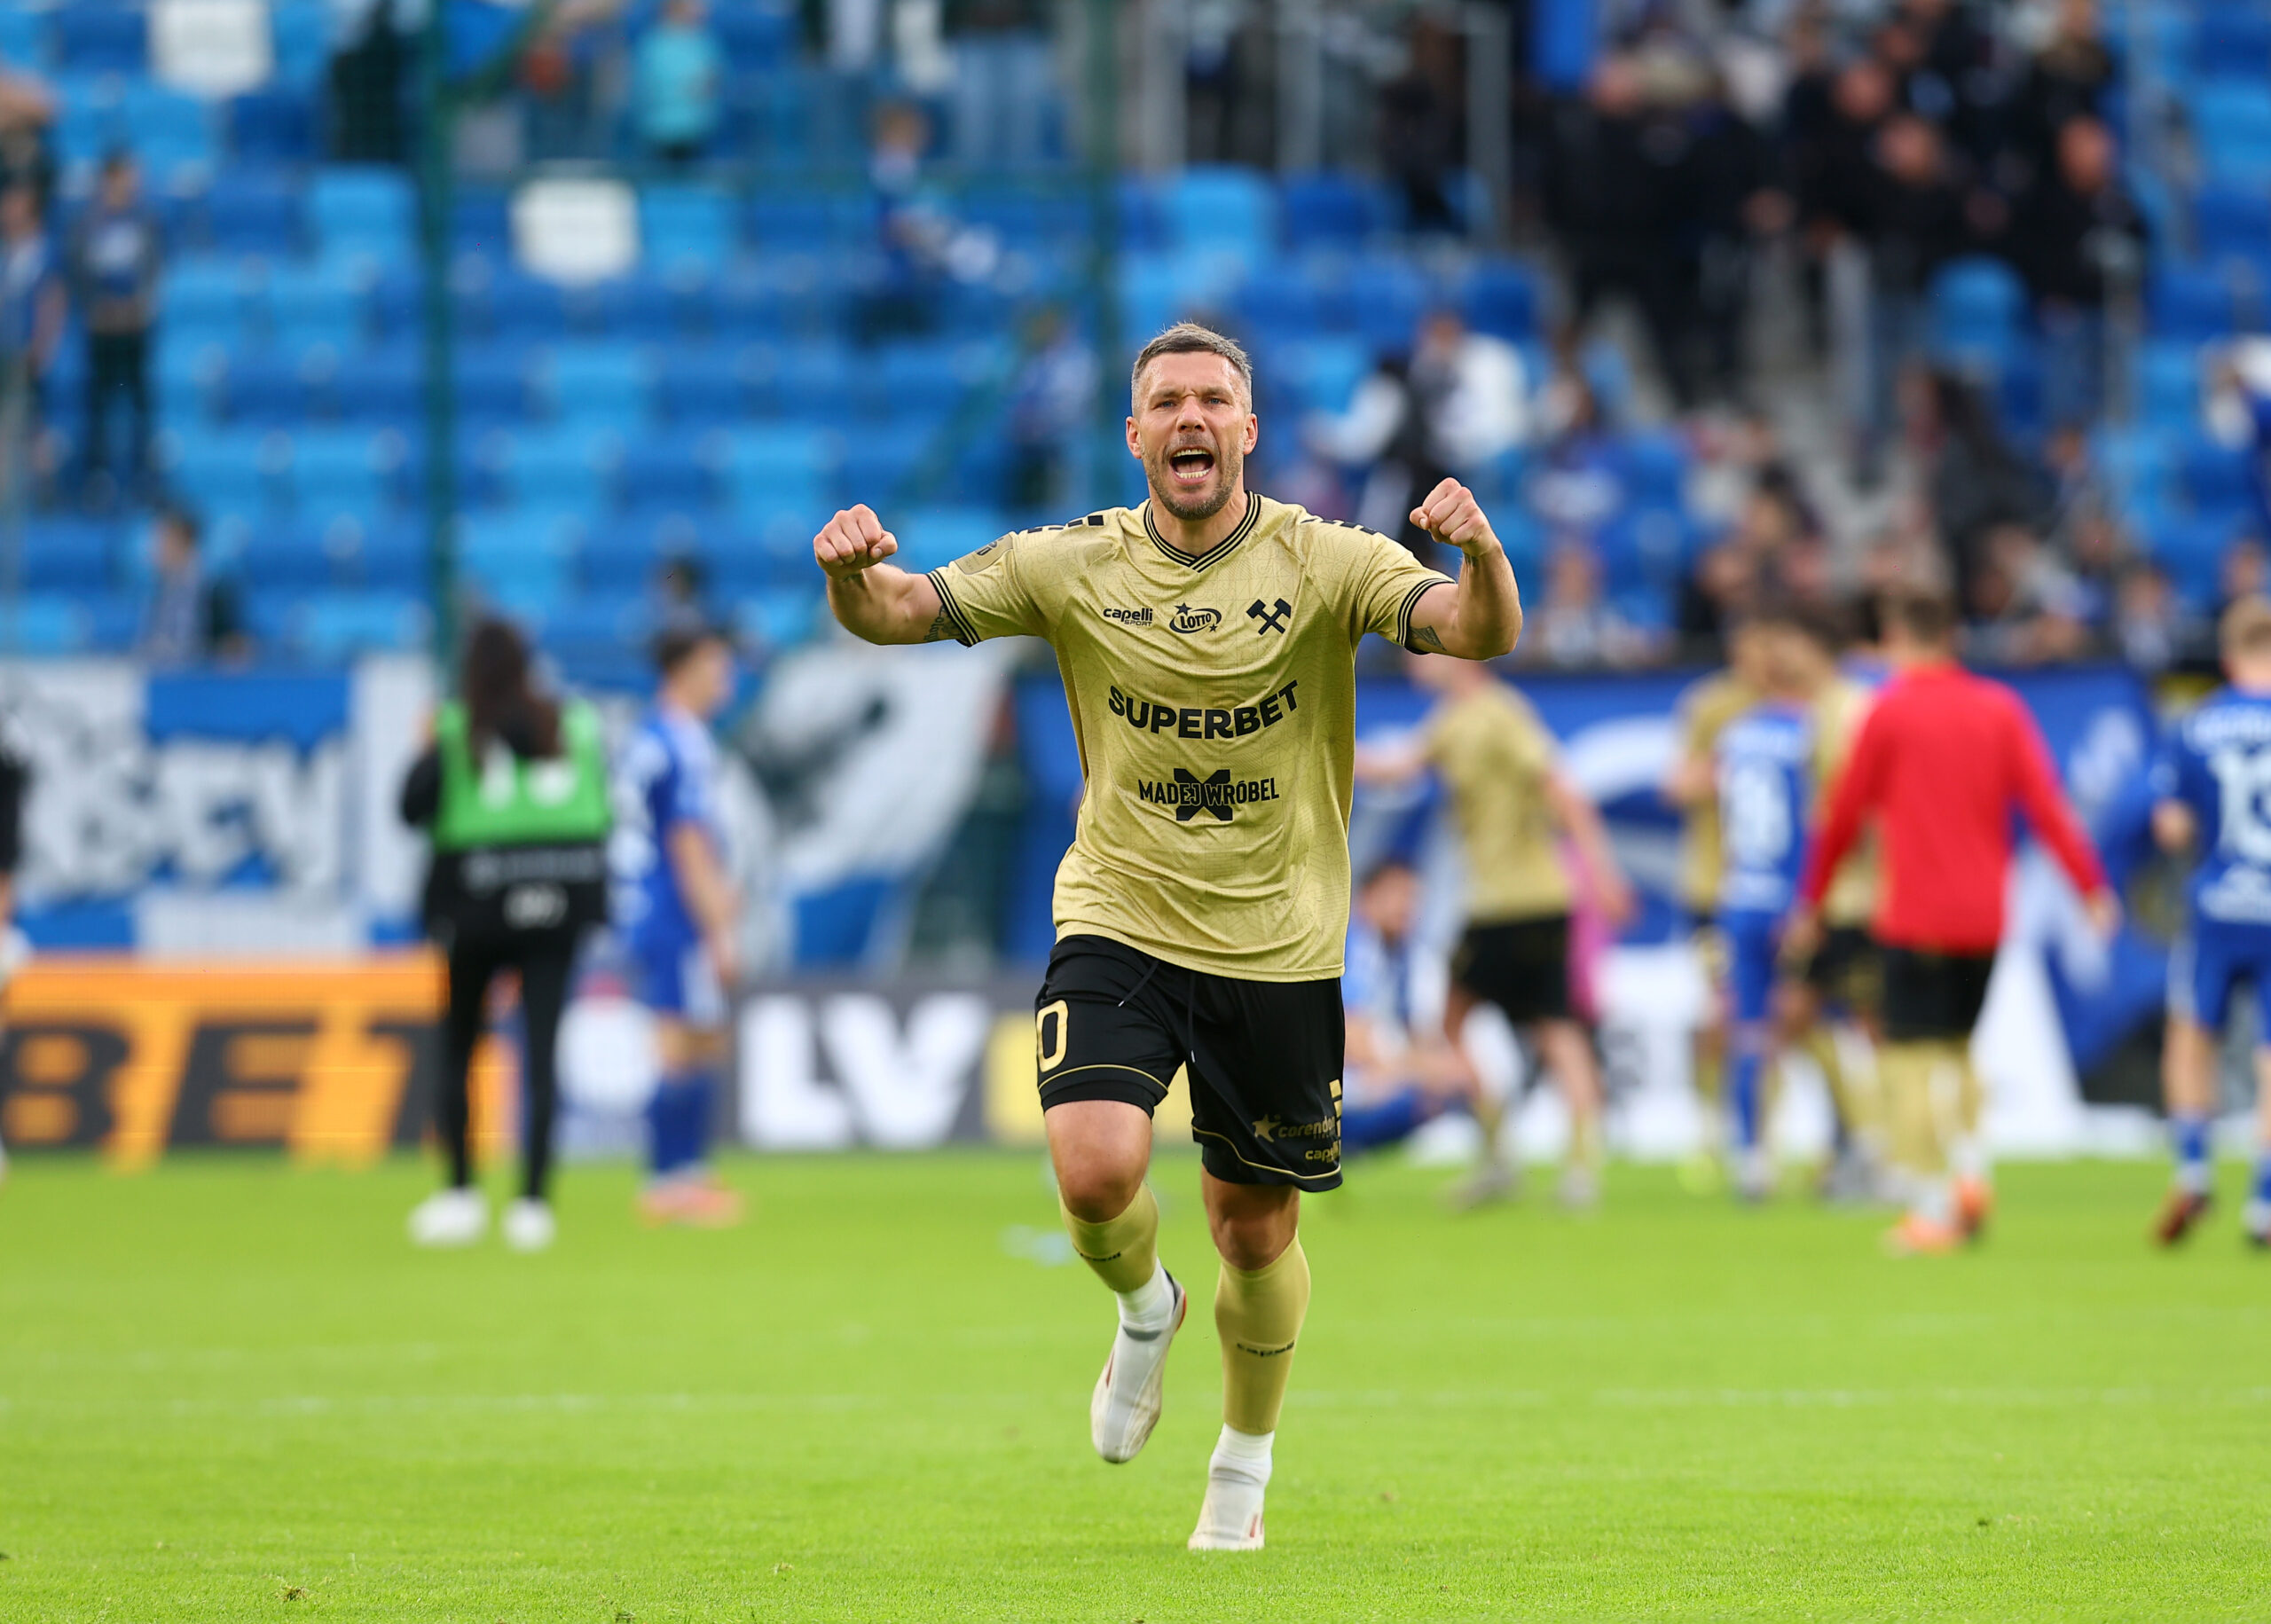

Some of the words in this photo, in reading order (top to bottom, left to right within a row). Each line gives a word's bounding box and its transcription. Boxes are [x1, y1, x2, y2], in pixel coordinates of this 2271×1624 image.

[1103, 608, 1153, 623] capelli
[1180, 613, 1213, 629] LOTTO
[1108, 679, 1298, 740] SUPERBET
[1138, 779, 1202, 806] MADEJ
[1205, 777, 1279, 806] WRÓBEL
